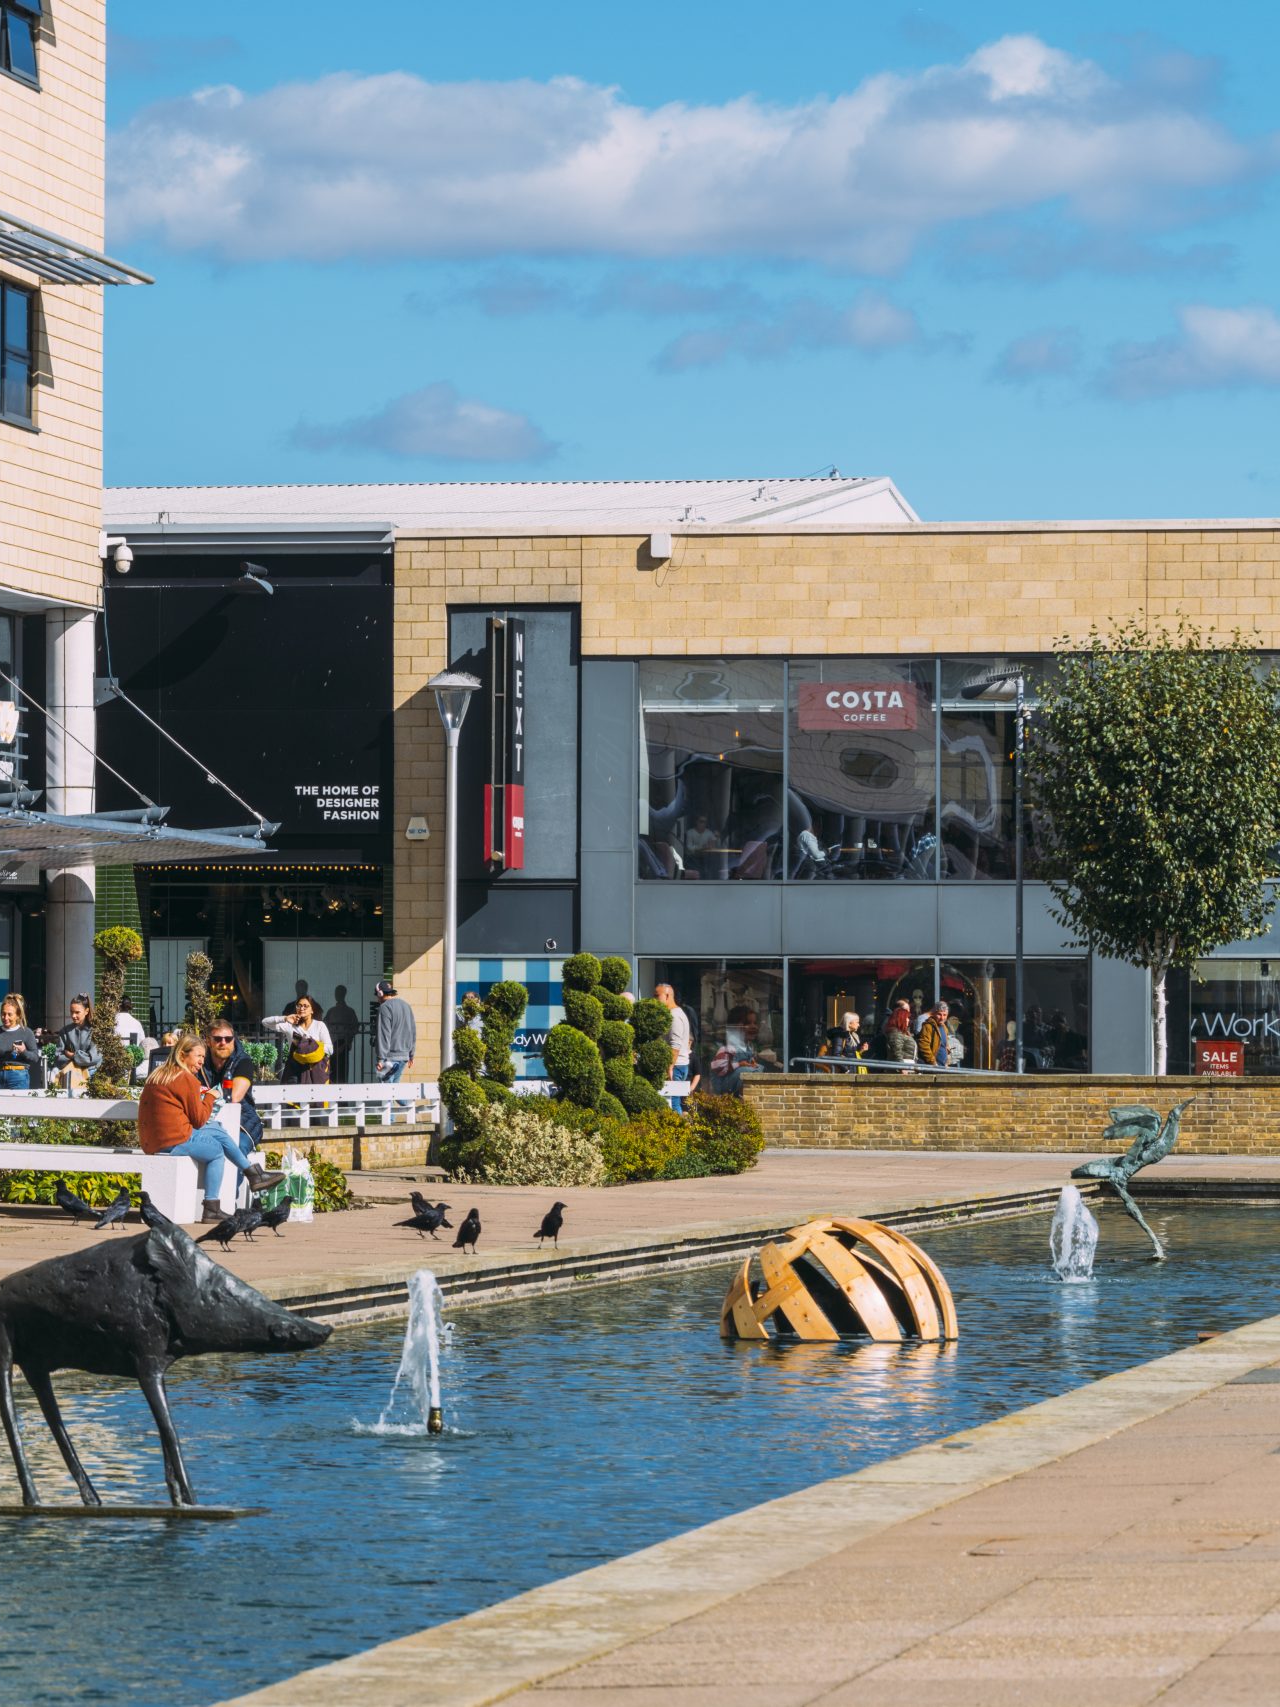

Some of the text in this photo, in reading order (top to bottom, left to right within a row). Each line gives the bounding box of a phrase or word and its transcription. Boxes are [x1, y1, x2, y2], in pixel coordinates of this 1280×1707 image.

[515, 632, 523, 772] NEXT
[825, 691, 904, 711] COSTA
[843, 713, 887, 722] COFFEE
[295, 786, 380, 795] THE HOME OF
[316, 798, 380, 808] DESIGNER
[323, 811, 380, 820] FASHION
[1202, 1051, 1238, 1063] SALE
